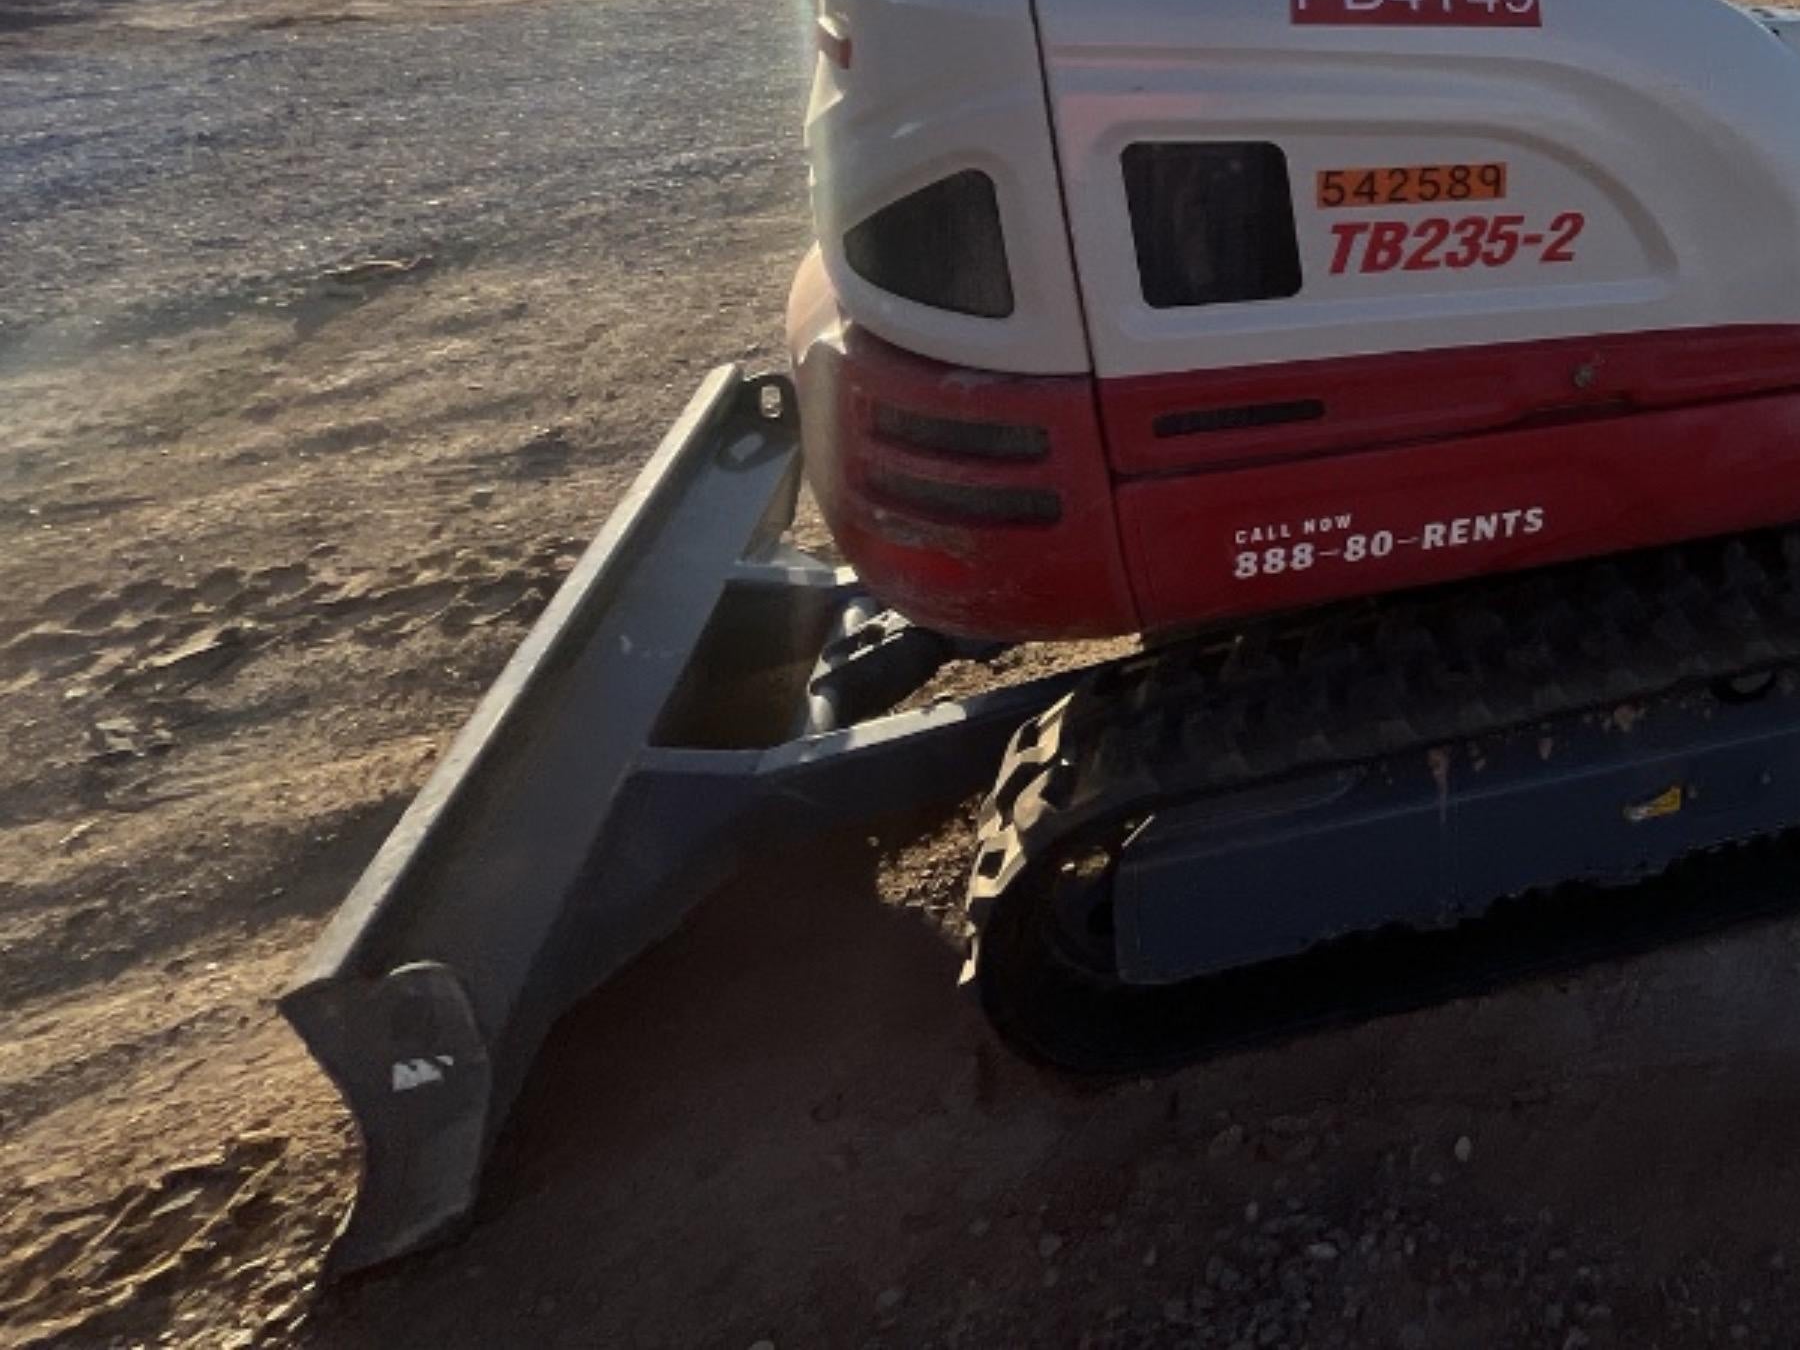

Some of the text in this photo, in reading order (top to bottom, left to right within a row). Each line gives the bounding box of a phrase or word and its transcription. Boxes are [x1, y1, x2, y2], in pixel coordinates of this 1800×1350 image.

[1321, 164, 1502, 206] 542589
[1328, 212, 1585, 275] TB235-2
[1235, 513, 1352, 545] CALL NOW
